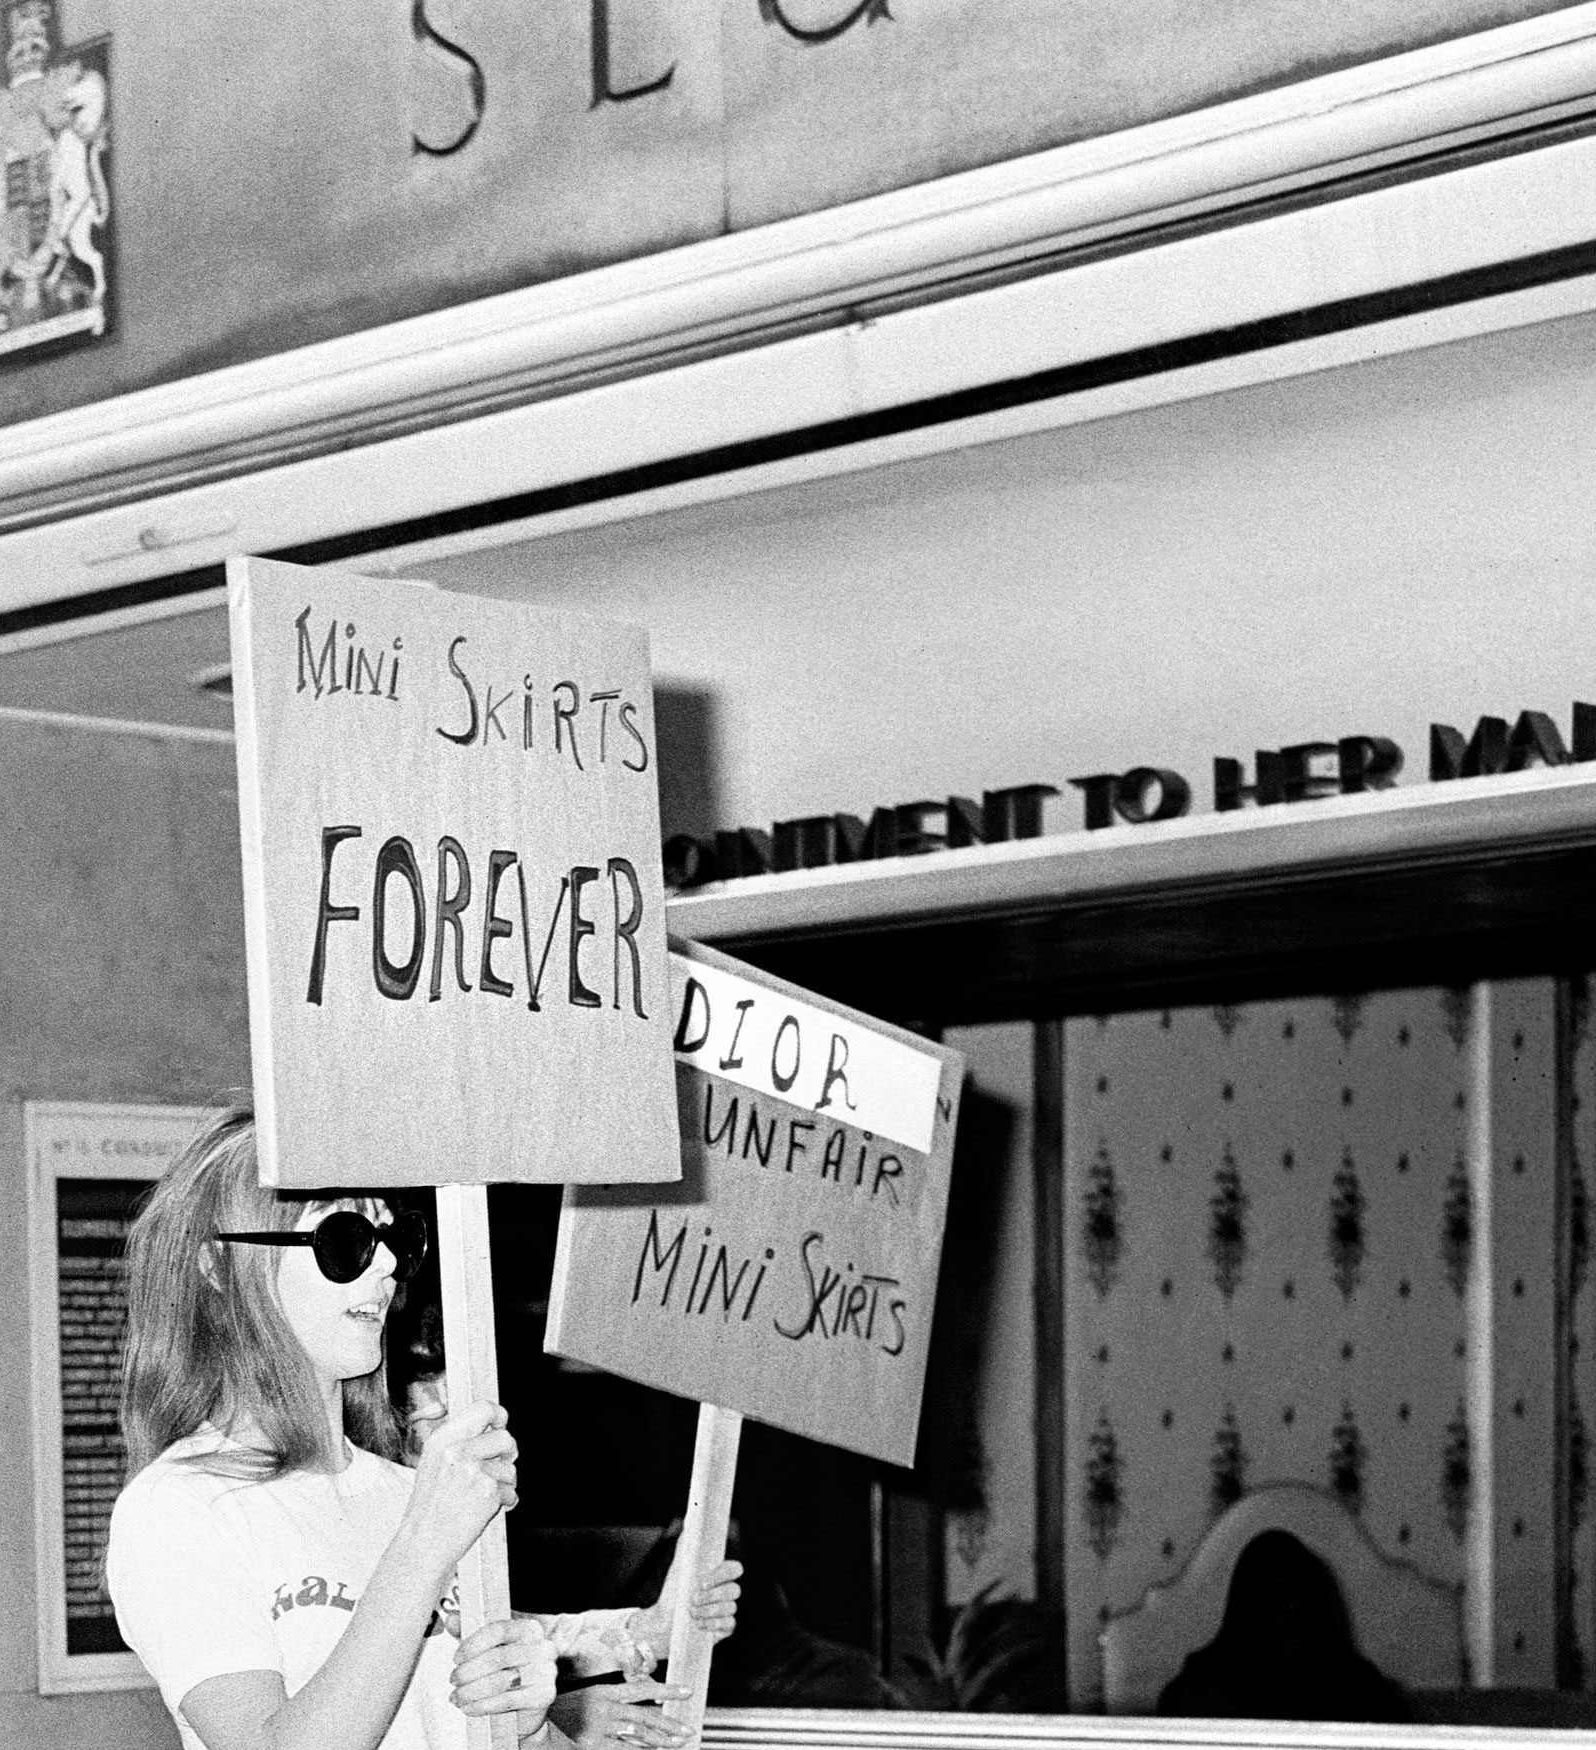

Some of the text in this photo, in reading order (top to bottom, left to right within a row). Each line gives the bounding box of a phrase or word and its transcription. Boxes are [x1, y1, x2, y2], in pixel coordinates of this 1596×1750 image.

[1068, 766, 1192, 831] TO
[1213, 735, 1405, 813] HER
[306, 825, 650, 1021] FOREVER
[673, 977, 857, 1110] DIOR
